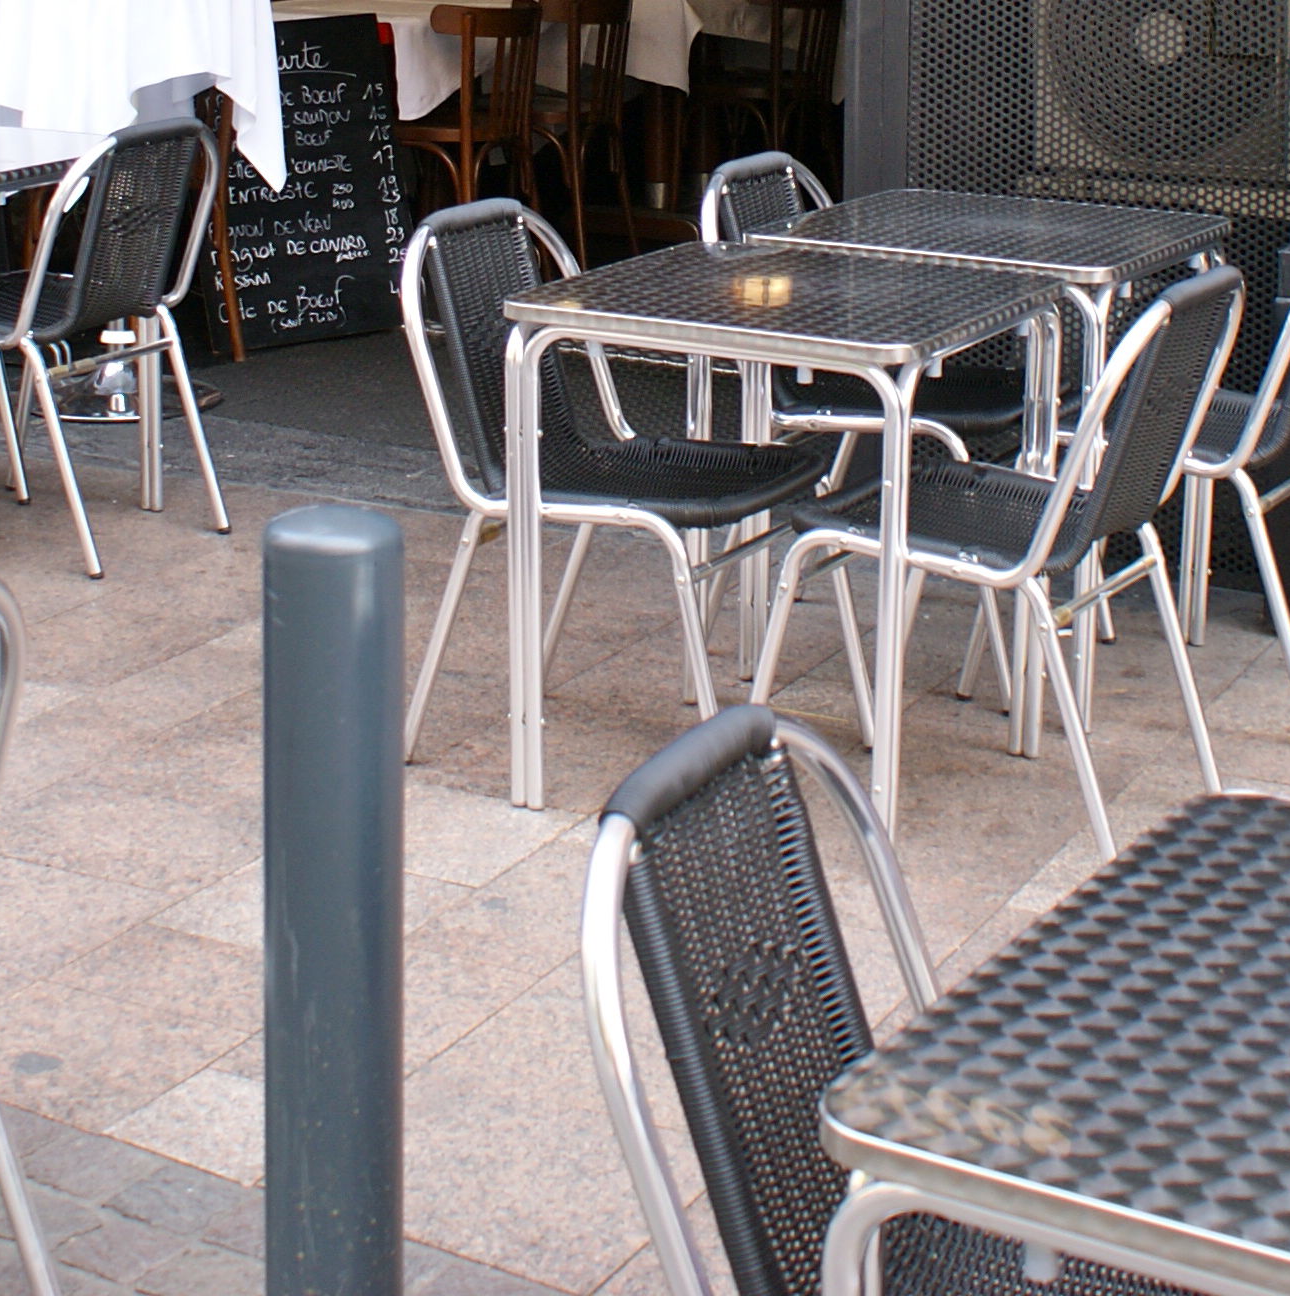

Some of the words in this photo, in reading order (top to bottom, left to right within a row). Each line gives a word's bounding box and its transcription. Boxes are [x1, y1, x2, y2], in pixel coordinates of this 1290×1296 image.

[278, 41, 329, 70] arte
[362, 83, 384, 101] 15
[373, 144, 395, 171] 17
[384, 207, 399, 225] 18
[286, 240, 307, 255] DE
[385, 227, 405, 244] 23
